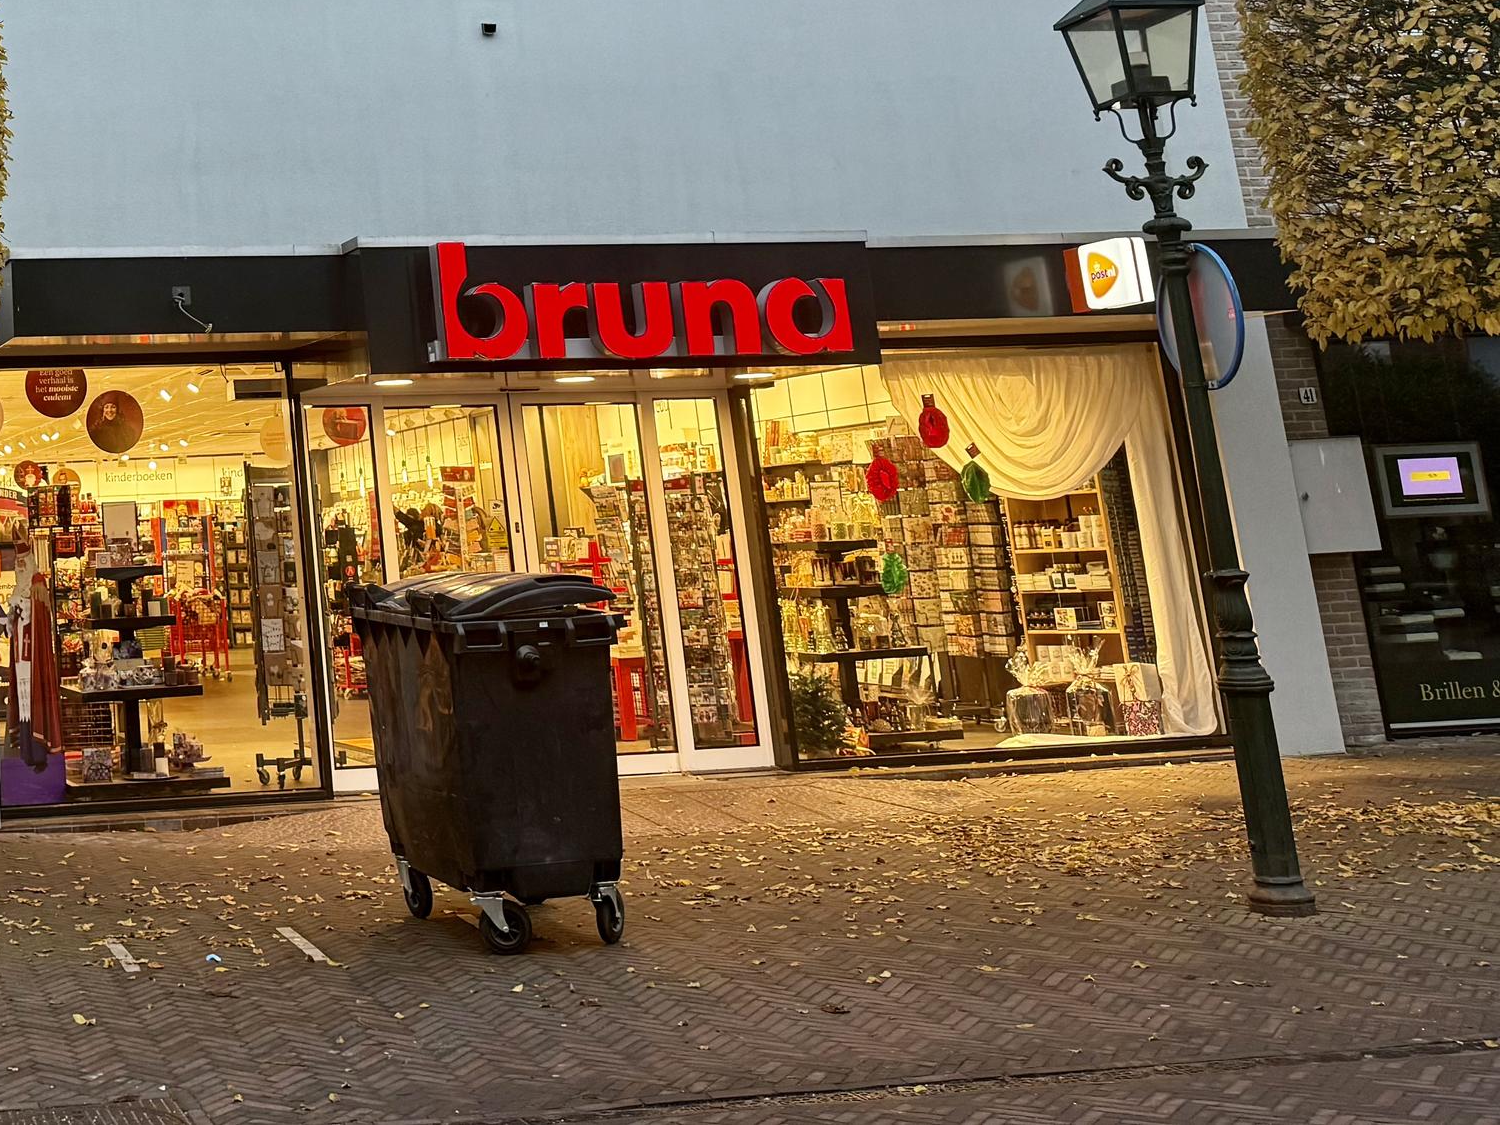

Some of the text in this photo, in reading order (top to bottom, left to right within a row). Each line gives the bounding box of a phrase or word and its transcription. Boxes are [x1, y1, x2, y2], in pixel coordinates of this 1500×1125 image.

[430, 242, 854, 361] bruna
[38, 376, 66, 385] verhaal
[35, 384, 79, 393] het mooiste
[1303, 388, 1315, 403] 41
[105, 471, 173, 483] kinderboeken
[1419, 681, 1486, 701] Brillen
